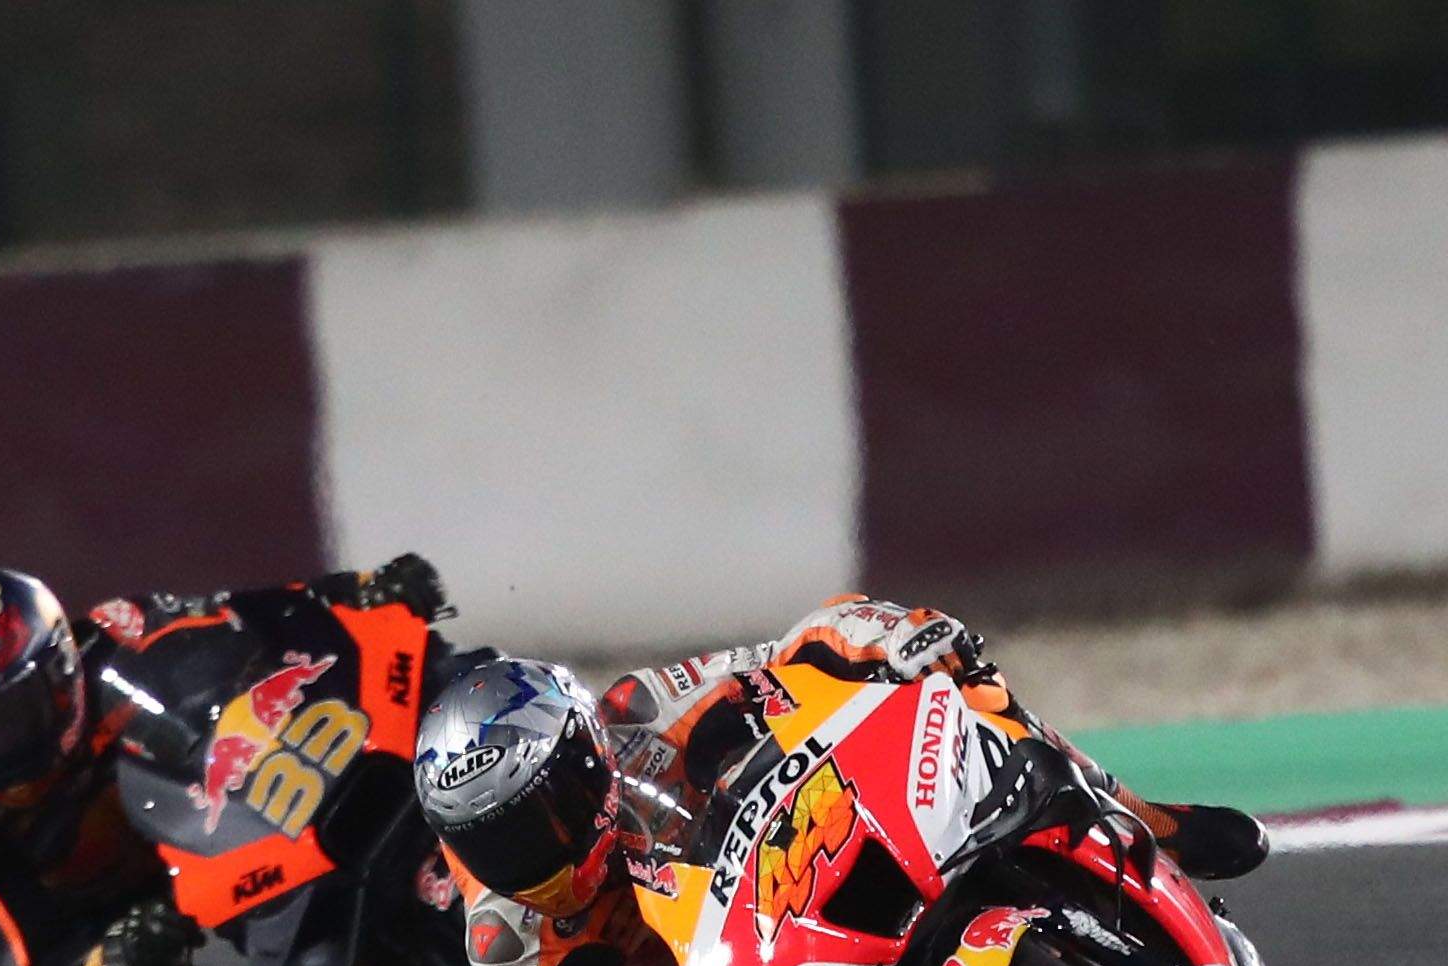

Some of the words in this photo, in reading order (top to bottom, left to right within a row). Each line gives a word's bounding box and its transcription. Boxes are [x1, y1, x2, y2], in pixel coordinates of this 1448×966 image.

[246, 699, 371, 840] 33
[444, 748, 495, 787] HJC
[915, 689, 951, 809] HONDA
[710, 736, 833, 907] REPSOL
